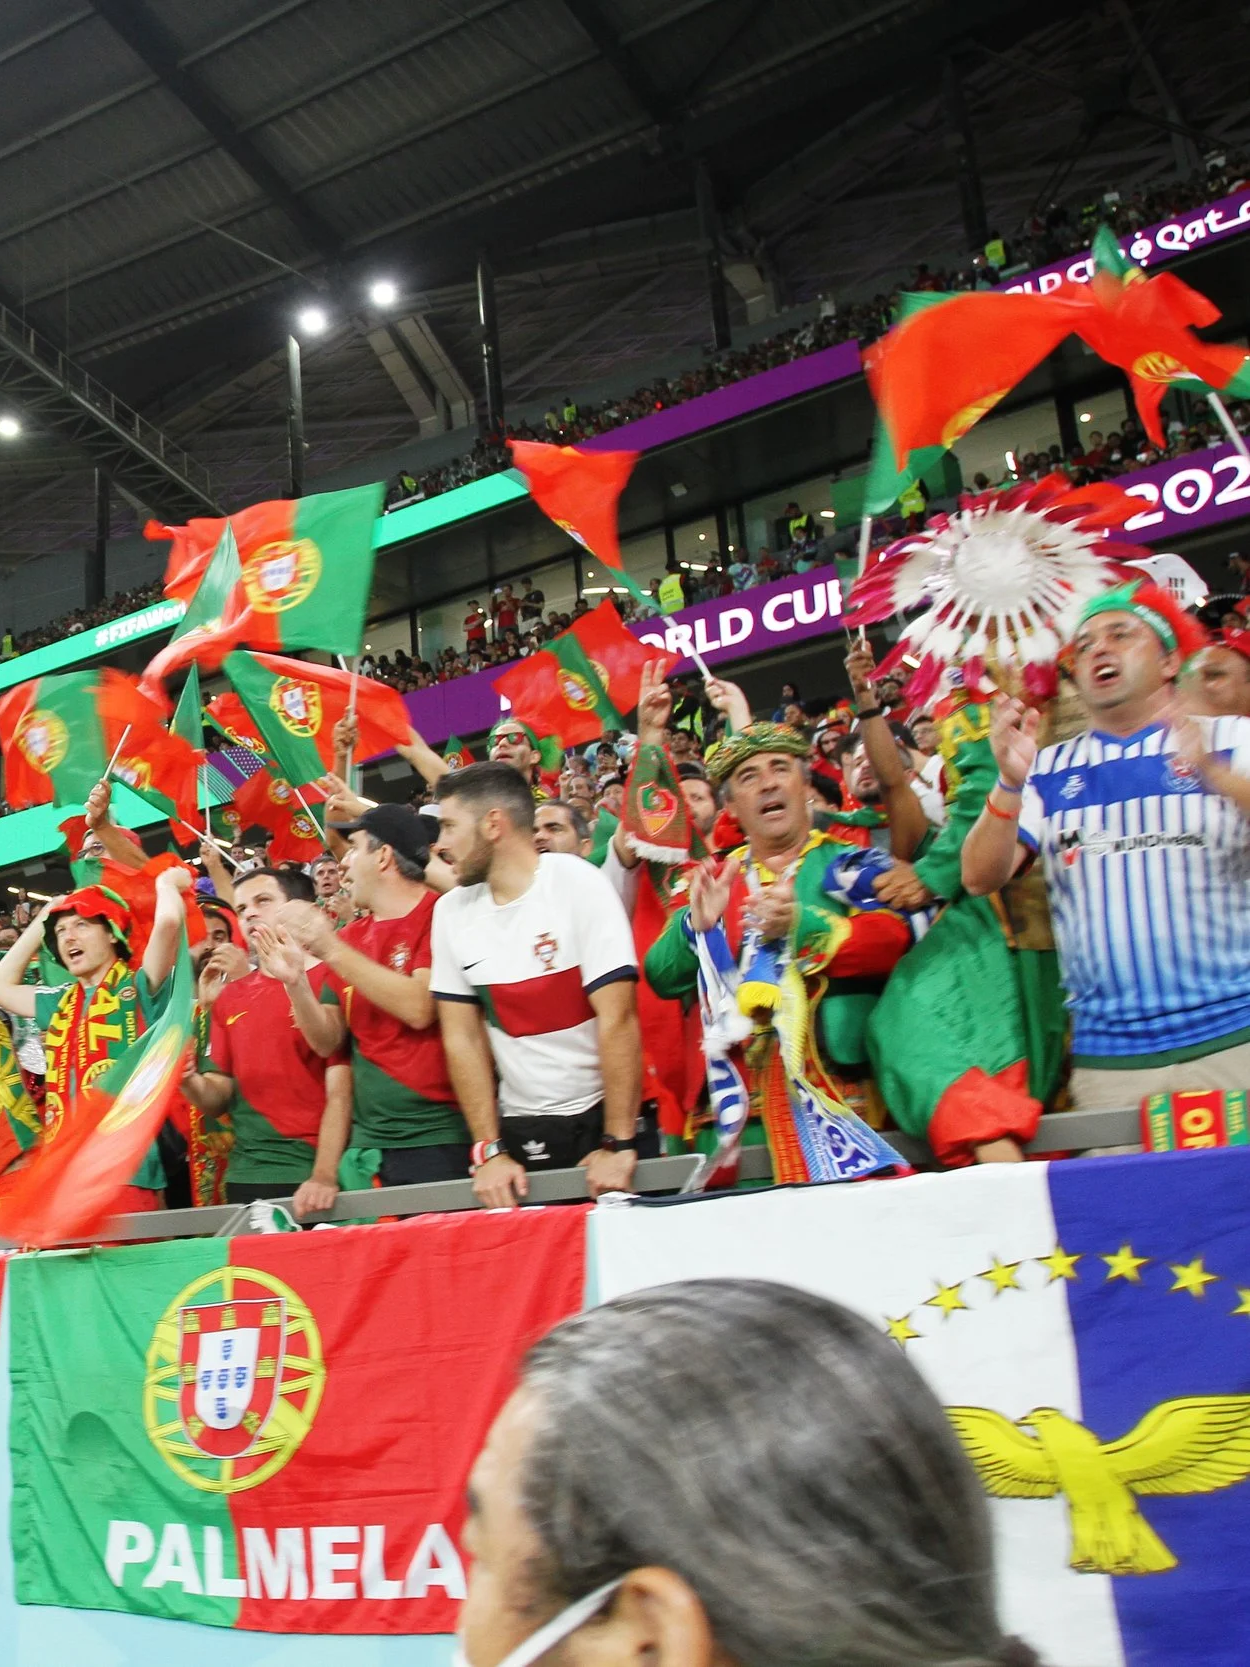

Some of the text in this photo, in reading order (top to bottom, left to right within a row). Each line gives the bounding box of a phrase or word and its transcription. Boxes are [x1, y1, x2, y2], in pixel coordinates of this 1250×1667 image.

[1123, 455, 1250, 531] 202
[125, 1011, 136, 1048] PORTU
[104, 1520, 467, 1600] PALMELA
